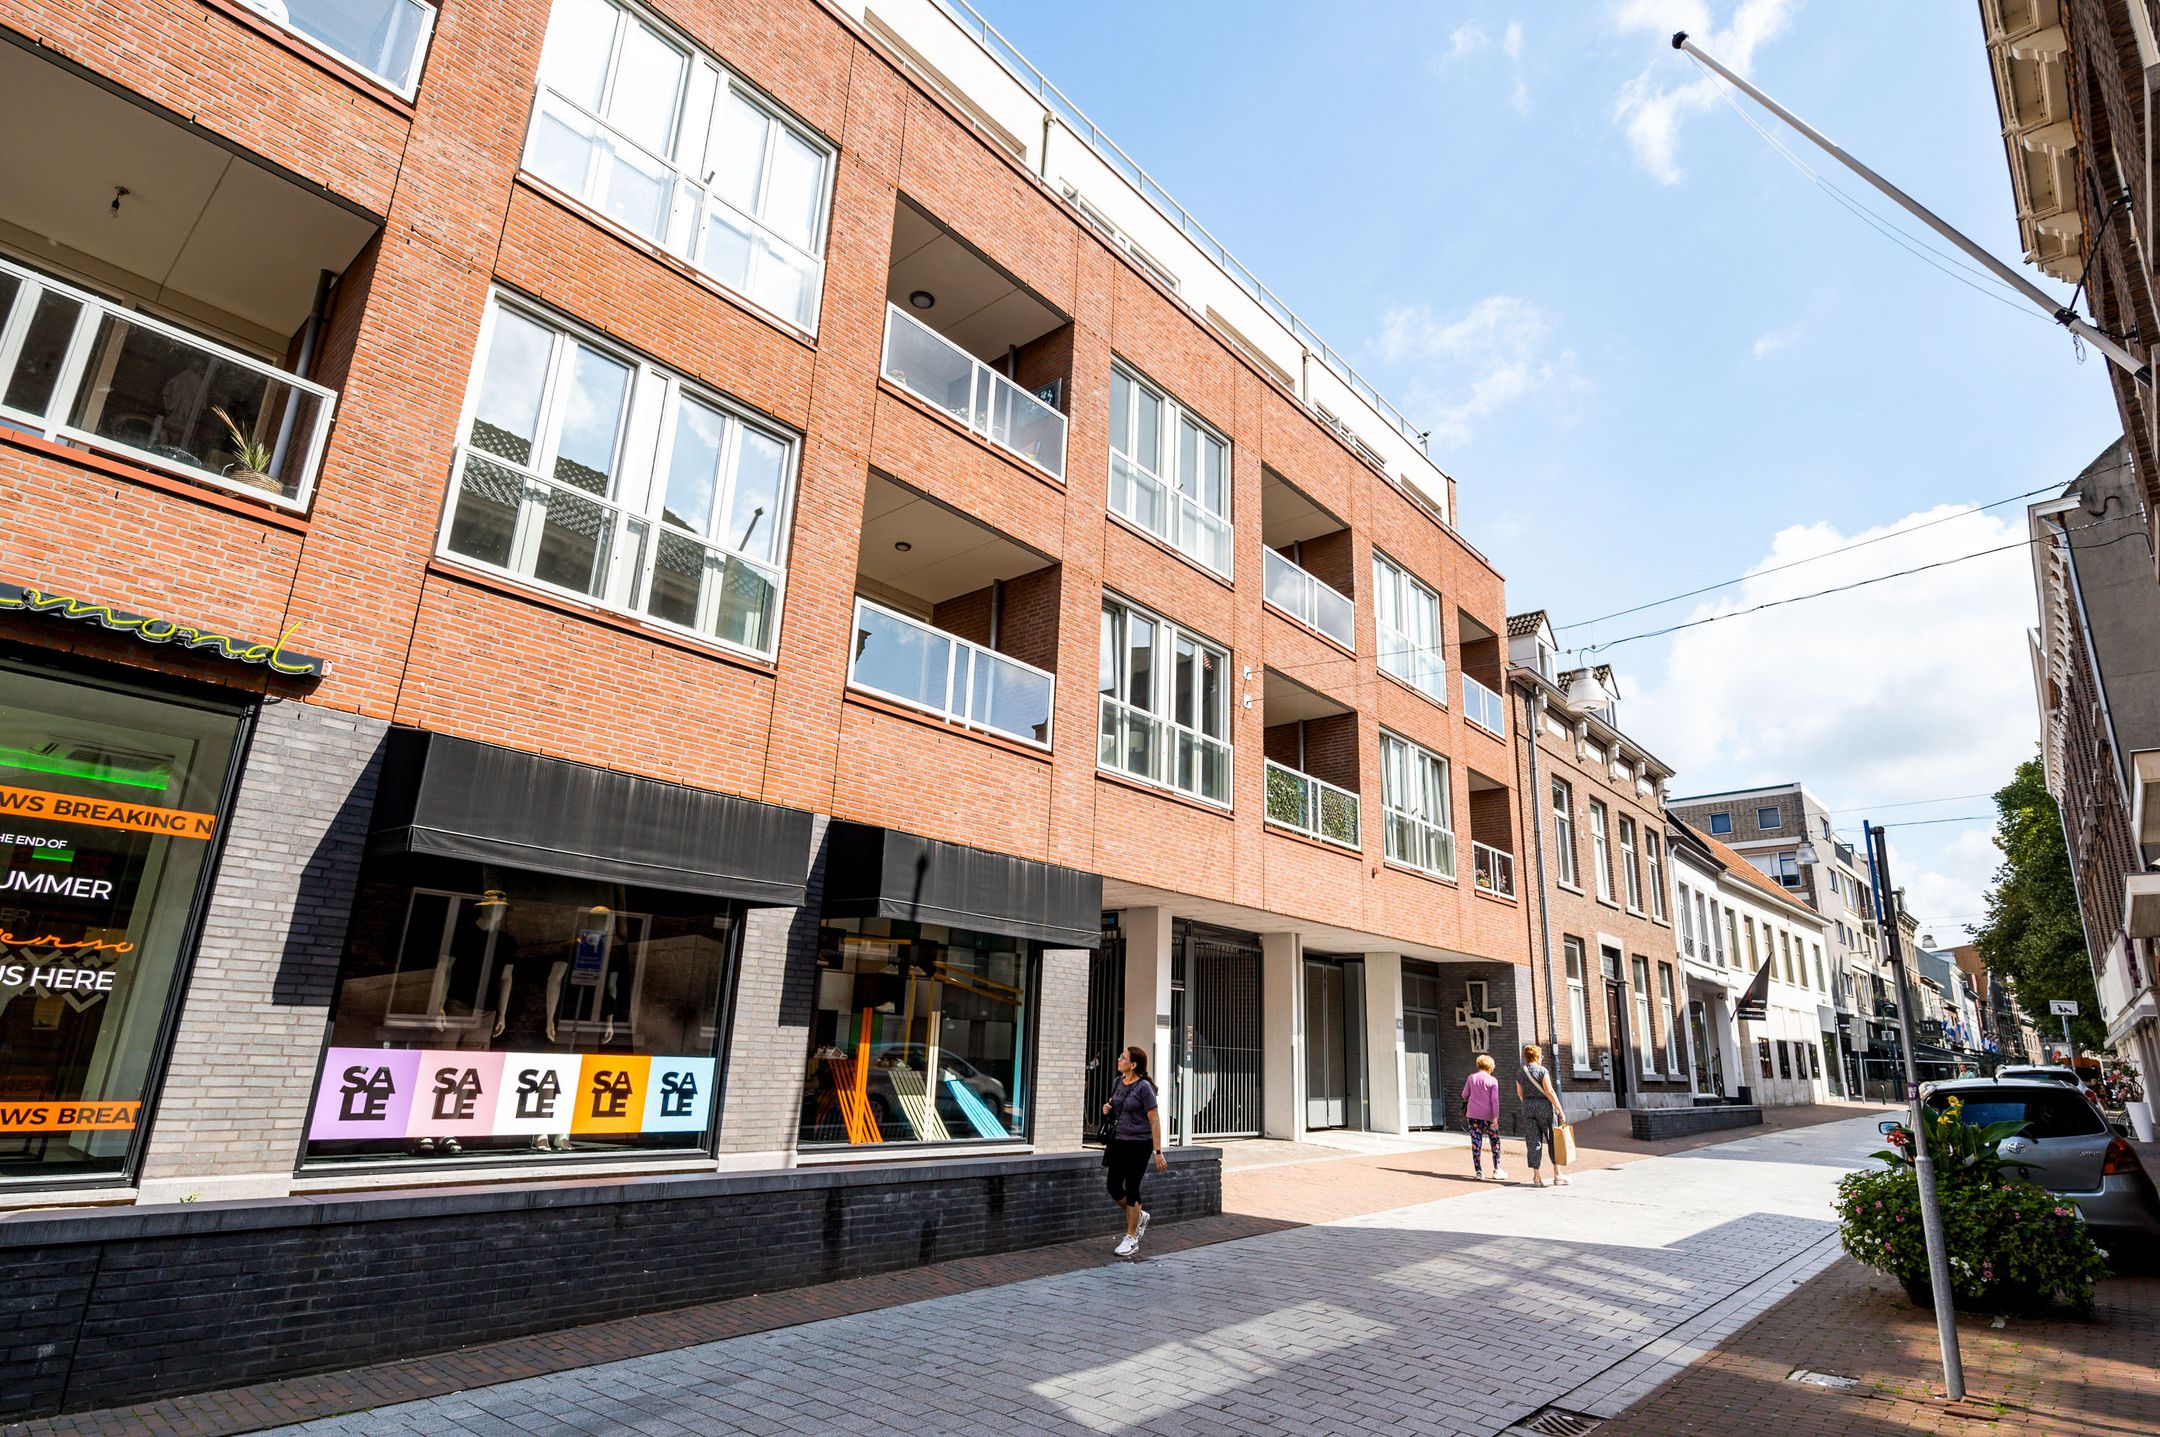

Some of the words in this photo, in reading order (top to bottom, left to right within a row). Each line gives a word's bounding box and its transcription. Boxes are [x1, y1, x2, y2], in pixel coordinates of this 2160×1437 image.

[0, 588, 314, 671] mond
[53, 799, 187, 831] BREAKING
[15, 835, 46, 847] END
[47, 839, 68, 849] OF
[0, 965, 25, 986] S
[29, 967, 116, 991] HERE
[57, 1107, 142, 1125] BREA
